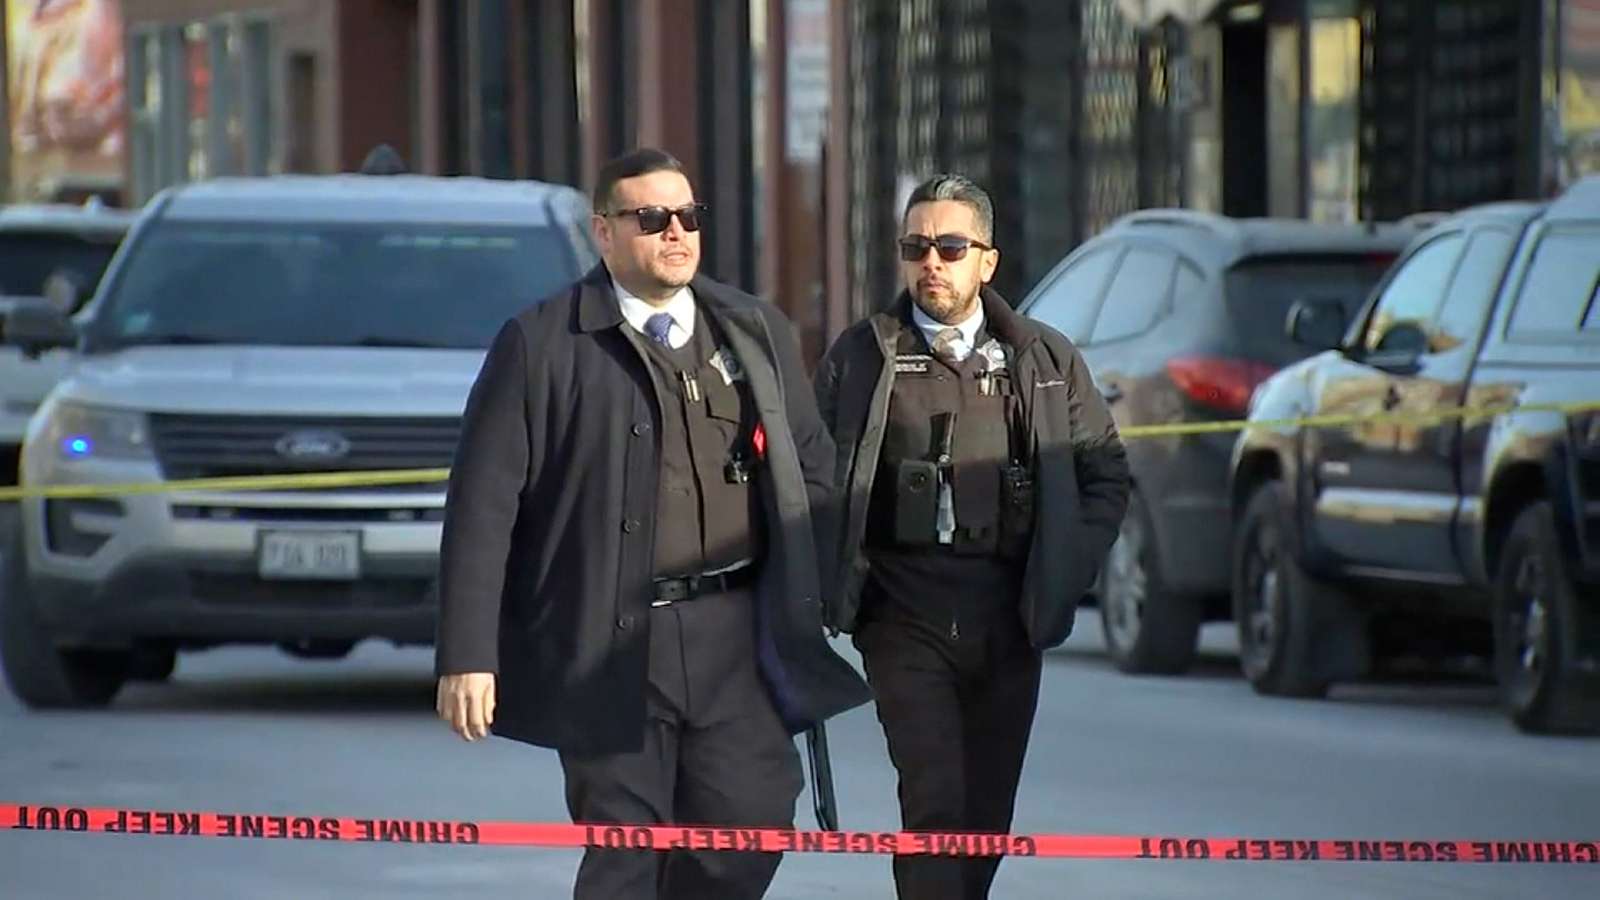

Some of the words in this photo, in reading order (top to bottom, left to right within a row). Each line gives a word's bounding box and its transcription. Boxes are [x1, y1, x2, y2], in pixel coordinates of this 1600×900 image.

[11, 806, 88, 832] OUT
[104, 811, 200, 836] KEEP
[216, 815, 341, 840] SCENE
[355, 819, 479, 844] CRIME
[578, 826, 654, 848] OUT
[670, 829, 760, 850] KEEP
[777, 831, 896, 854] SCENE
[911, 834, 1036, 857] CRIME
[1137, 838, 1210, 860] OUT
[1225, 840, 1319, 861] KEEP
[1334, 840, 1457, 862] SCENE
[1472, 842, 1600, 863] CRIME
